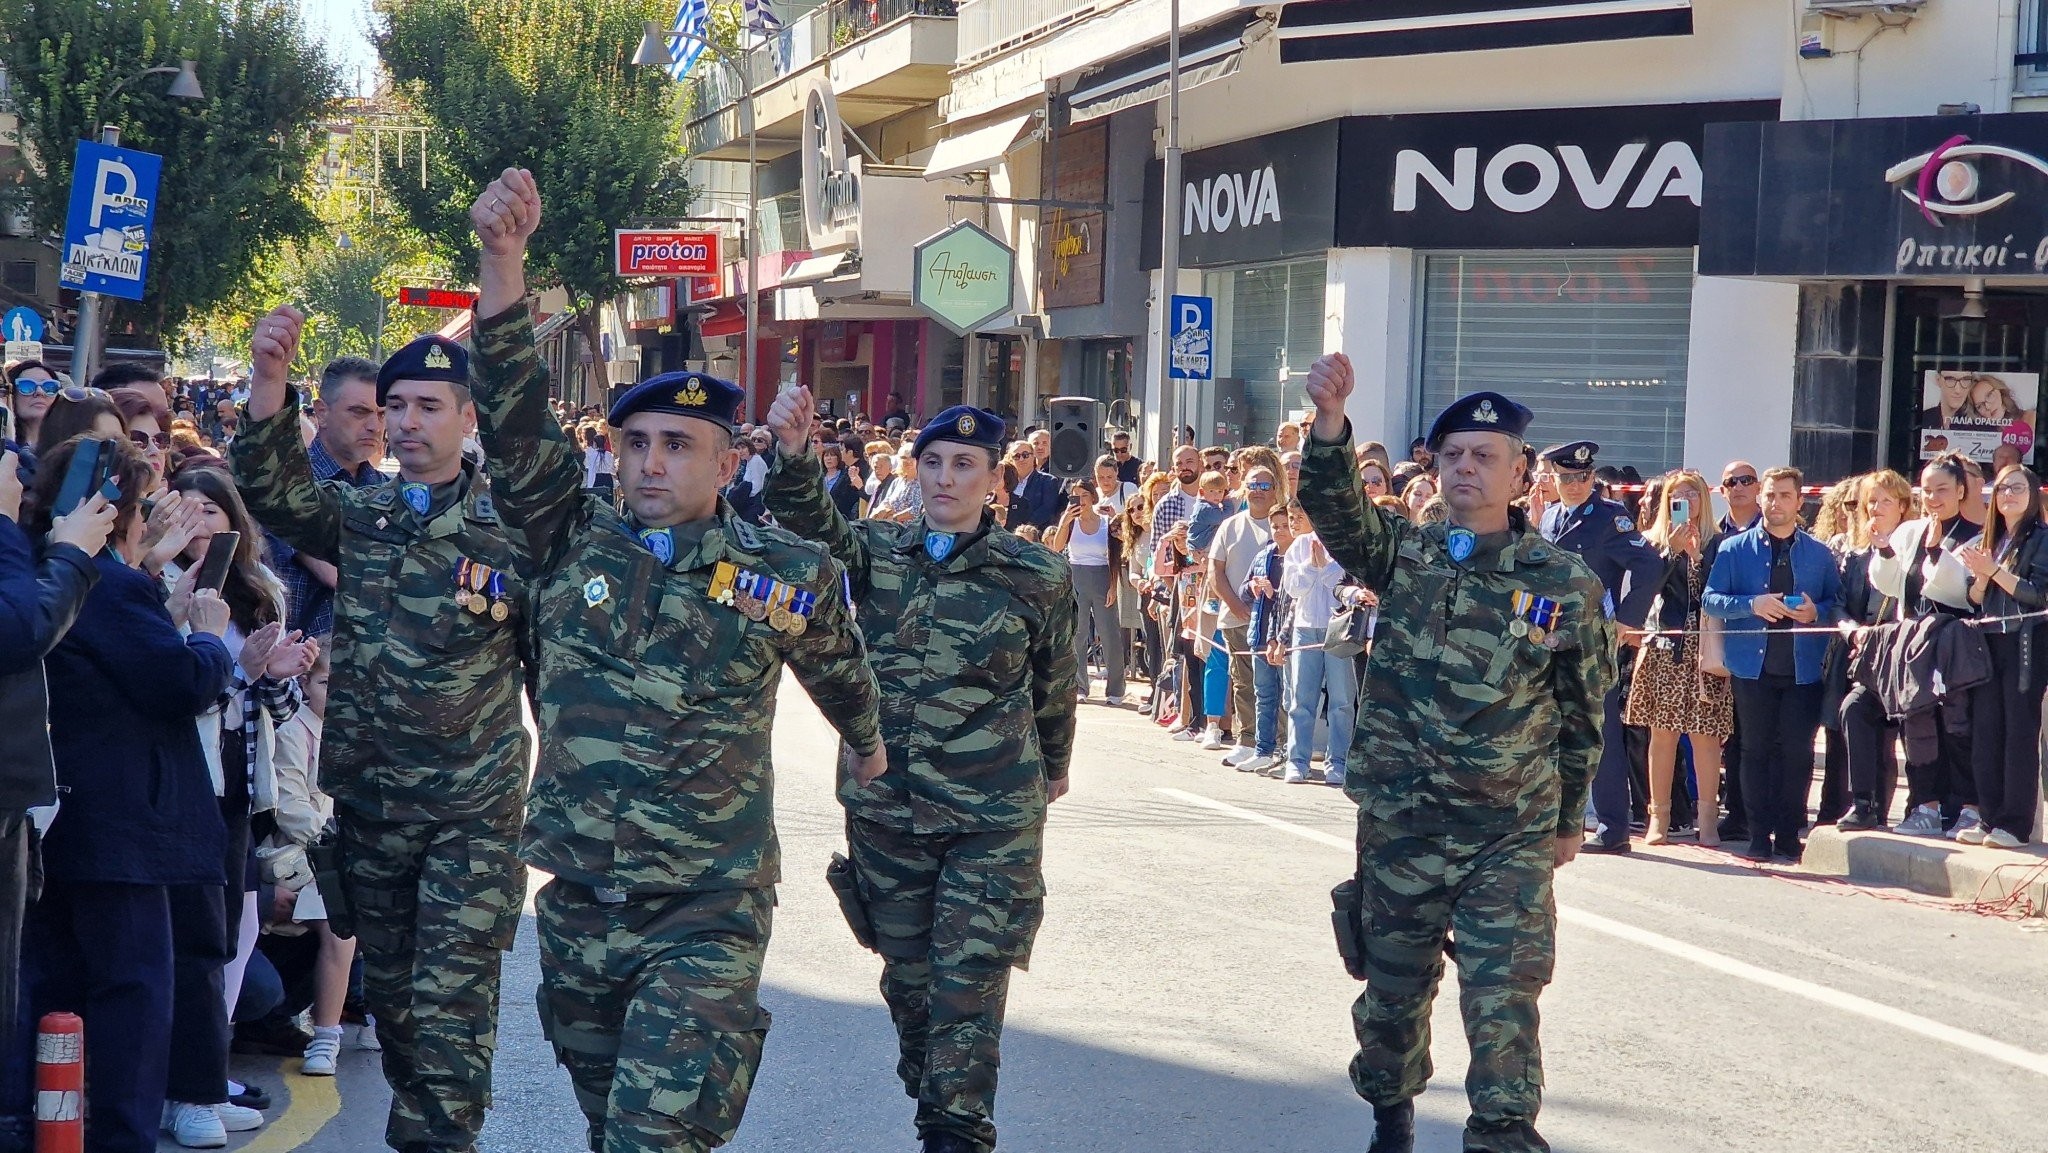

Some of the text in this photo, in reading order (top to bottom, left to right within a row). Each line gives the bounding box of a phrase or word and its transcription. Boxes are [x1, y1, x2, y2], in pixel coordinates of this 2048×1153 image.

[89, 158, 138, 229] P
[1393, 141, 1703, 213] NOVA
[1183, 166, 1281, 236] NOVA
[630, 240, 708, 270] proton
[1896, 234, 2014, 269] Οπτικοί
[1181, 303, 1202, 333] P
[1945, 416, 2014, 427] ΓΥΑΛΙΑ ΟΡΑΣΕΩΣ
